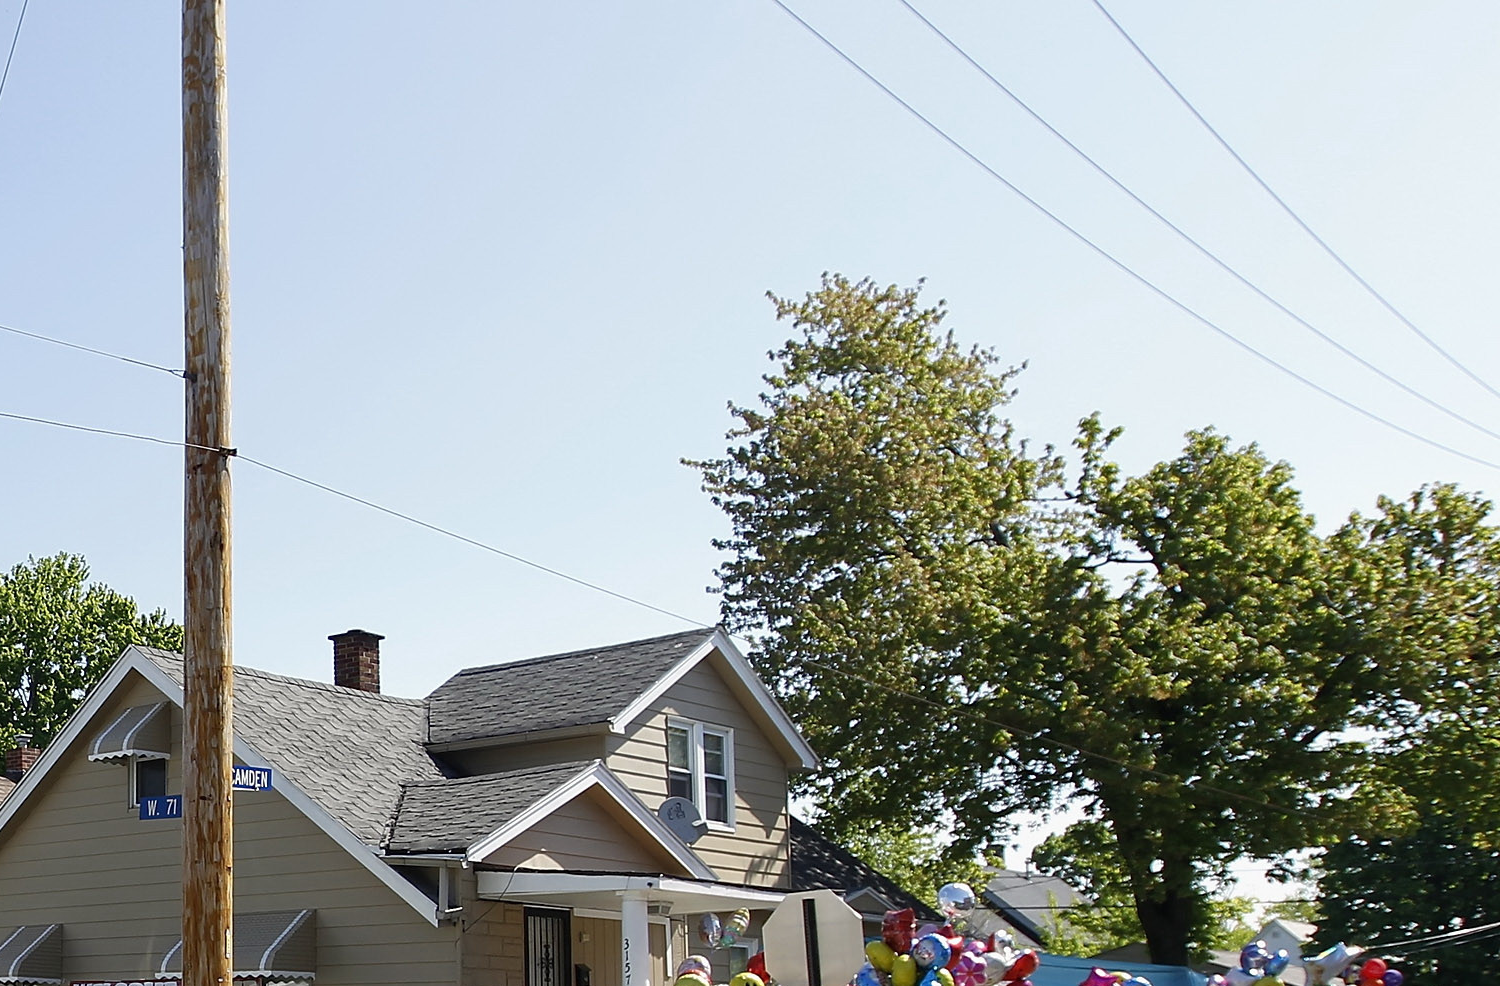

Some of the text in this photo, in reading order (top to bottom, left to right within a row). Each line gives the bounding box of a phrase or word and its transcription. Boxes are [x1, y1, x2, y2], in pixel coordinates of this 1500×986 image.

[147, 798, 177, 816] W. 71
[623, 937, 631, 985] 3157
